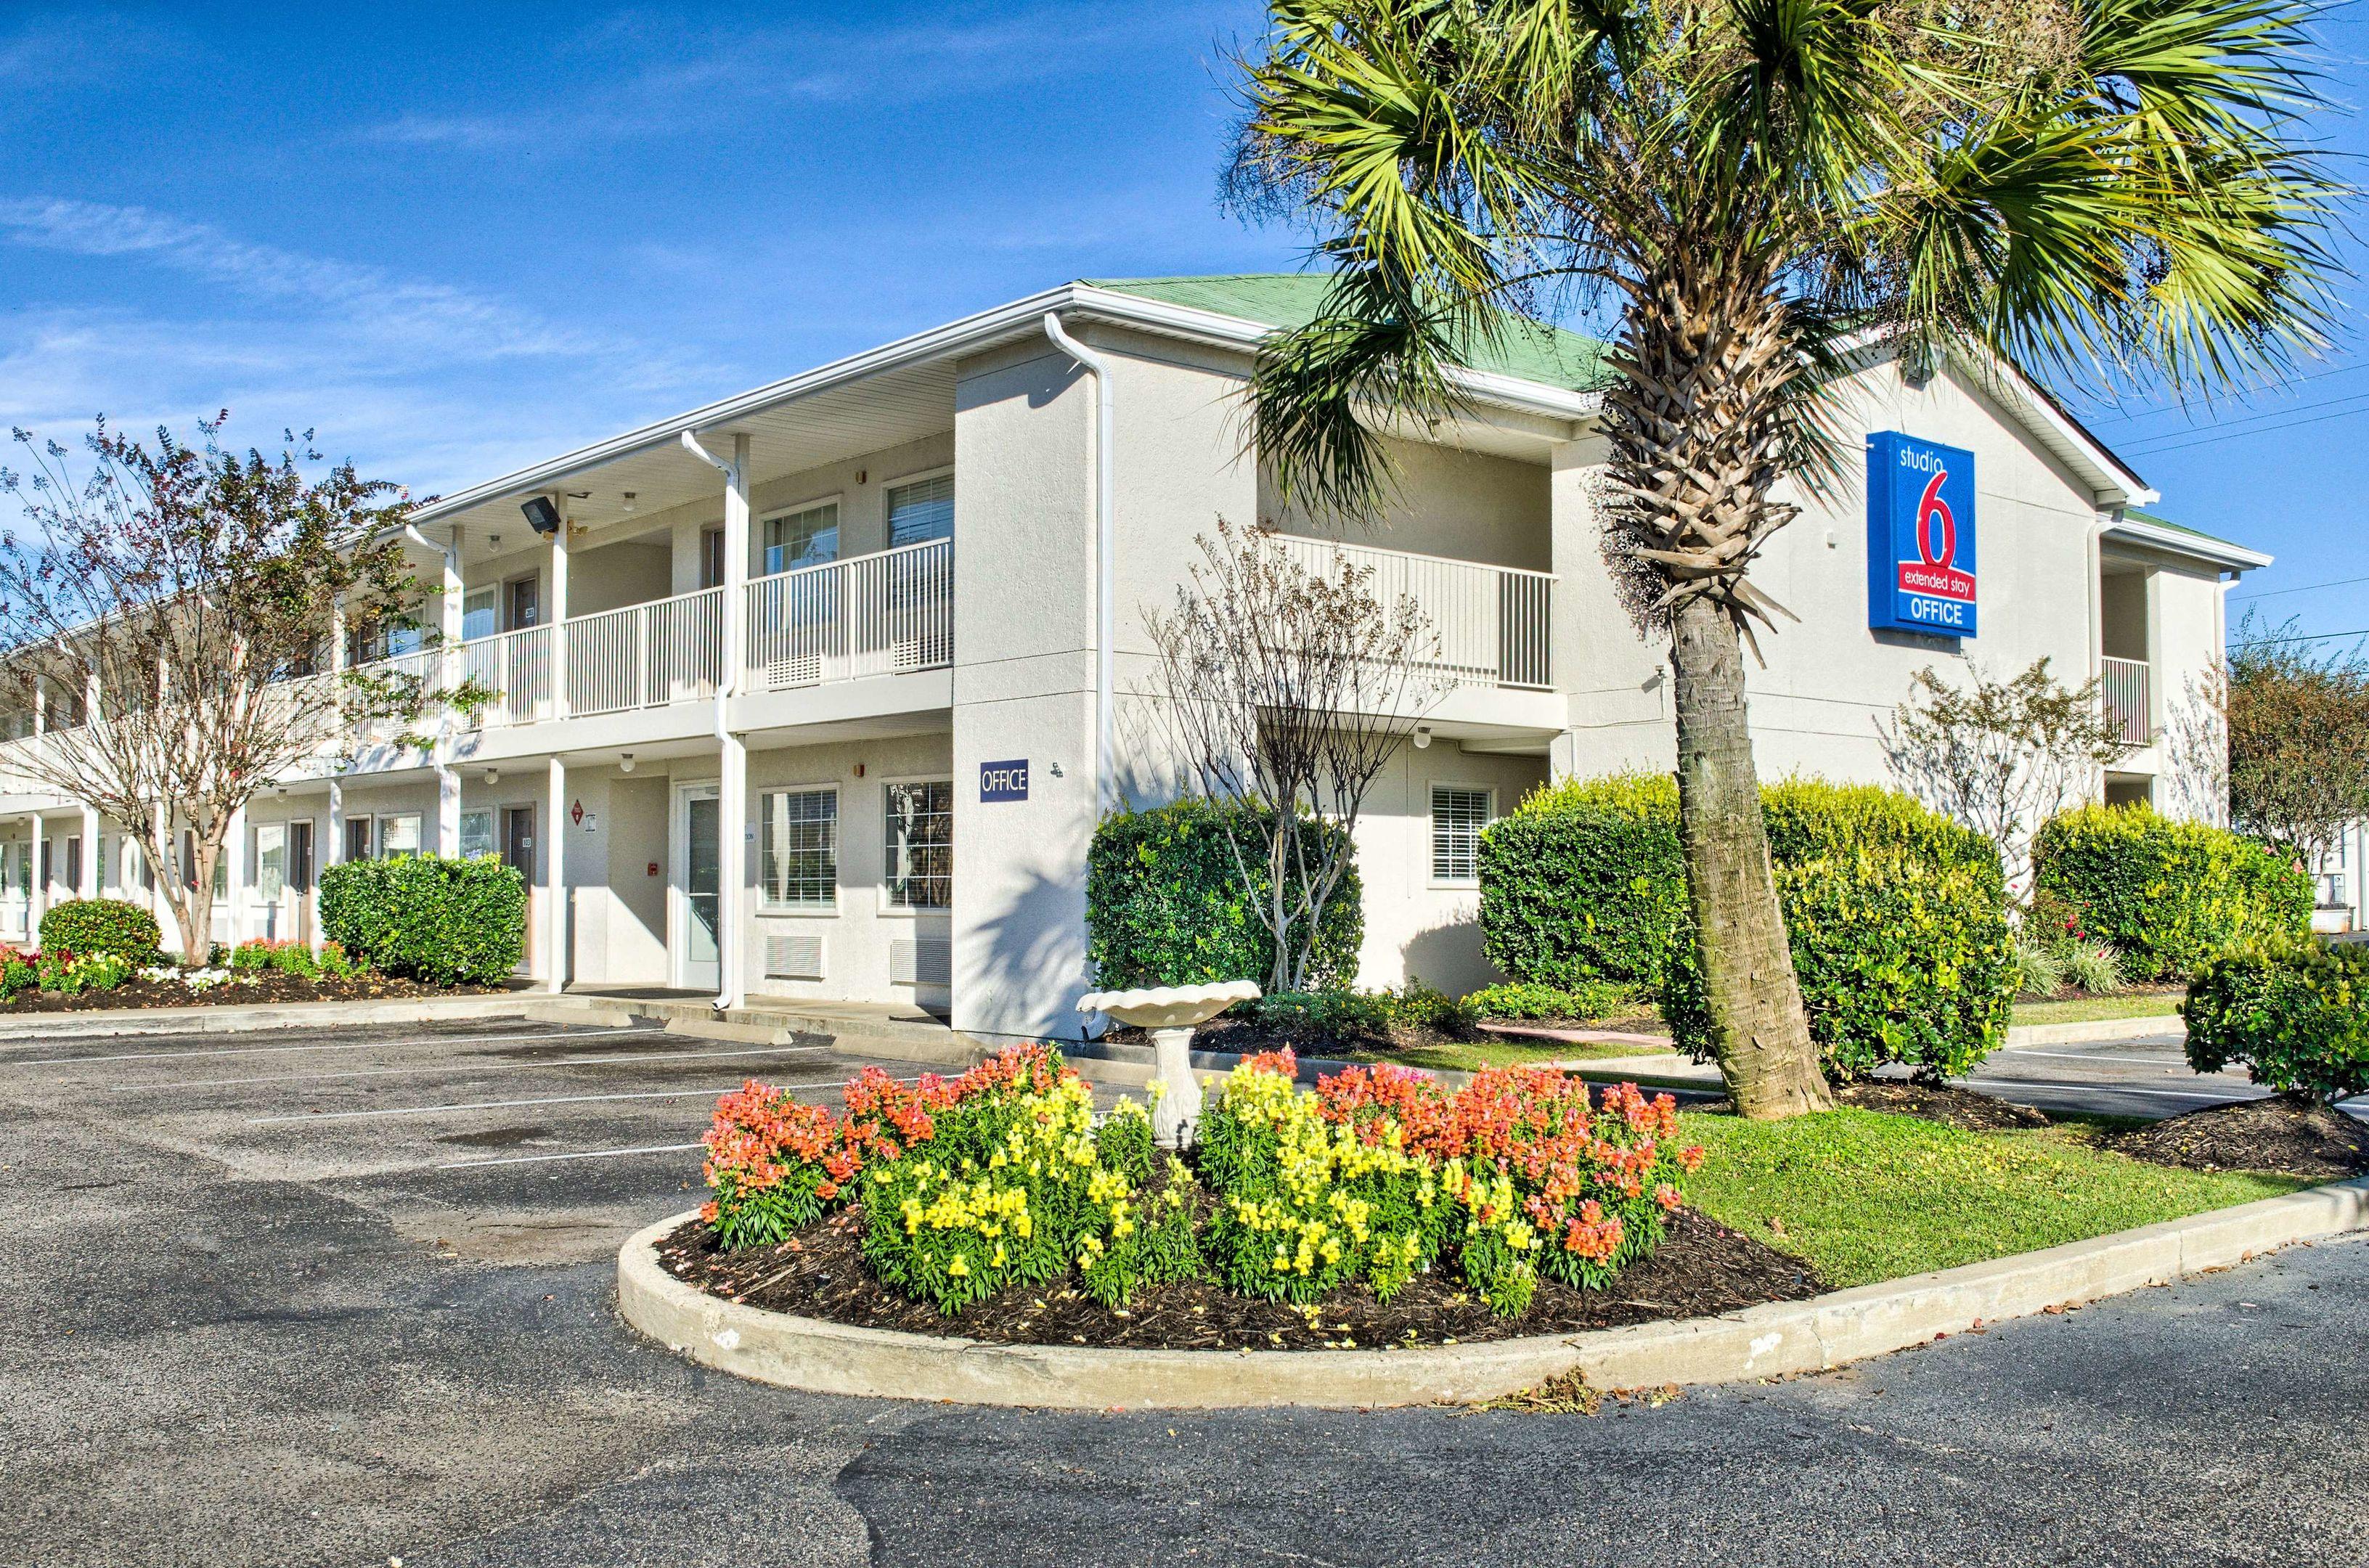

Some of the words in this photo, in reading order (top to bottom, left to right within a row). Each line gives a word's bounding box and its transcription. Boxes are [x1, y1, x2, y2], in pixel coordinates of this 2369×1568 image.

[1900, 446, 1944, 473] studio
[1917, 470, 1957, 569] 6
[1904, 570, 1949, 591] extended
[1950, 579, 1970, 597] stay
[1910, 597, 1962, 625] OFFICE
[982, 769, 1027, 792] OFFICE
